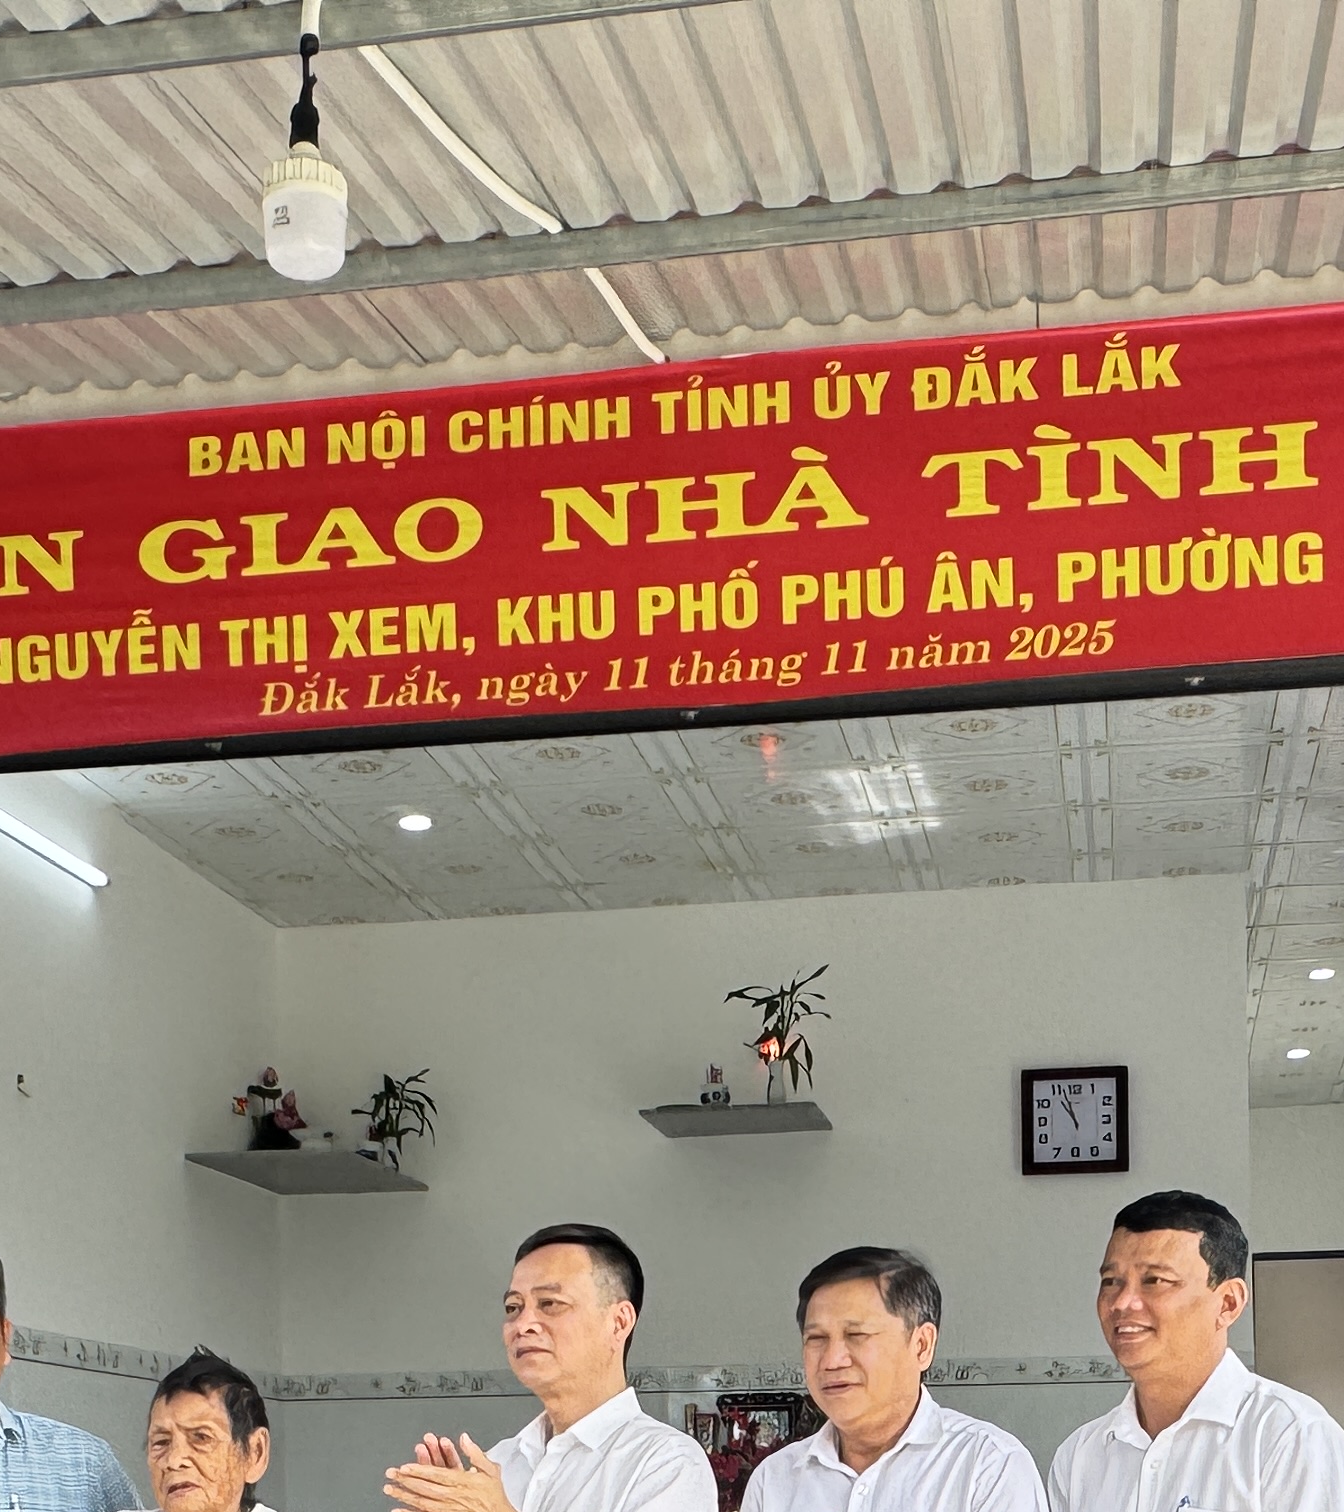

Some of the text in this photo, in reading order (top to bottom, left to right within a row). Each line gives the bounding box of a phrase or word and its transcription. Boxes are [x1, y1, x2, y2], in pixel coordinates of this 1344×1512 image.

[188, 331, 1182, 477] BAN NỘI CHÍNH TỈNH ỦY ĐẮK LẮK
[138, 497, 485, 585] GIAO
[540, 445, 871, 553] NHÀ
[921, 420, 1320, 519] TÌNH
[219, 614, 309, 673] THỊ
[328, 601, 476, 660] XEM,
[497, 589, 617, 647] KHU
[637, 558, 760, 636] PHỐ
[781, 555, 906, 626] PHÚ
[926, 549, 1035, 614] ÂN,
[1057, 526, 1325, 604] PHƯỜNG
[258, 618, 1116, 716] Đắk Lắk, ngày 11 tháng 11 năm 2025
[1036, 1098, 1051, 1109] 10
[1052, 1084, 1062, 1096] 11
[1090, 1083, 1095, 1095] 1
[1052, 1146, 1062, 1159] 7
